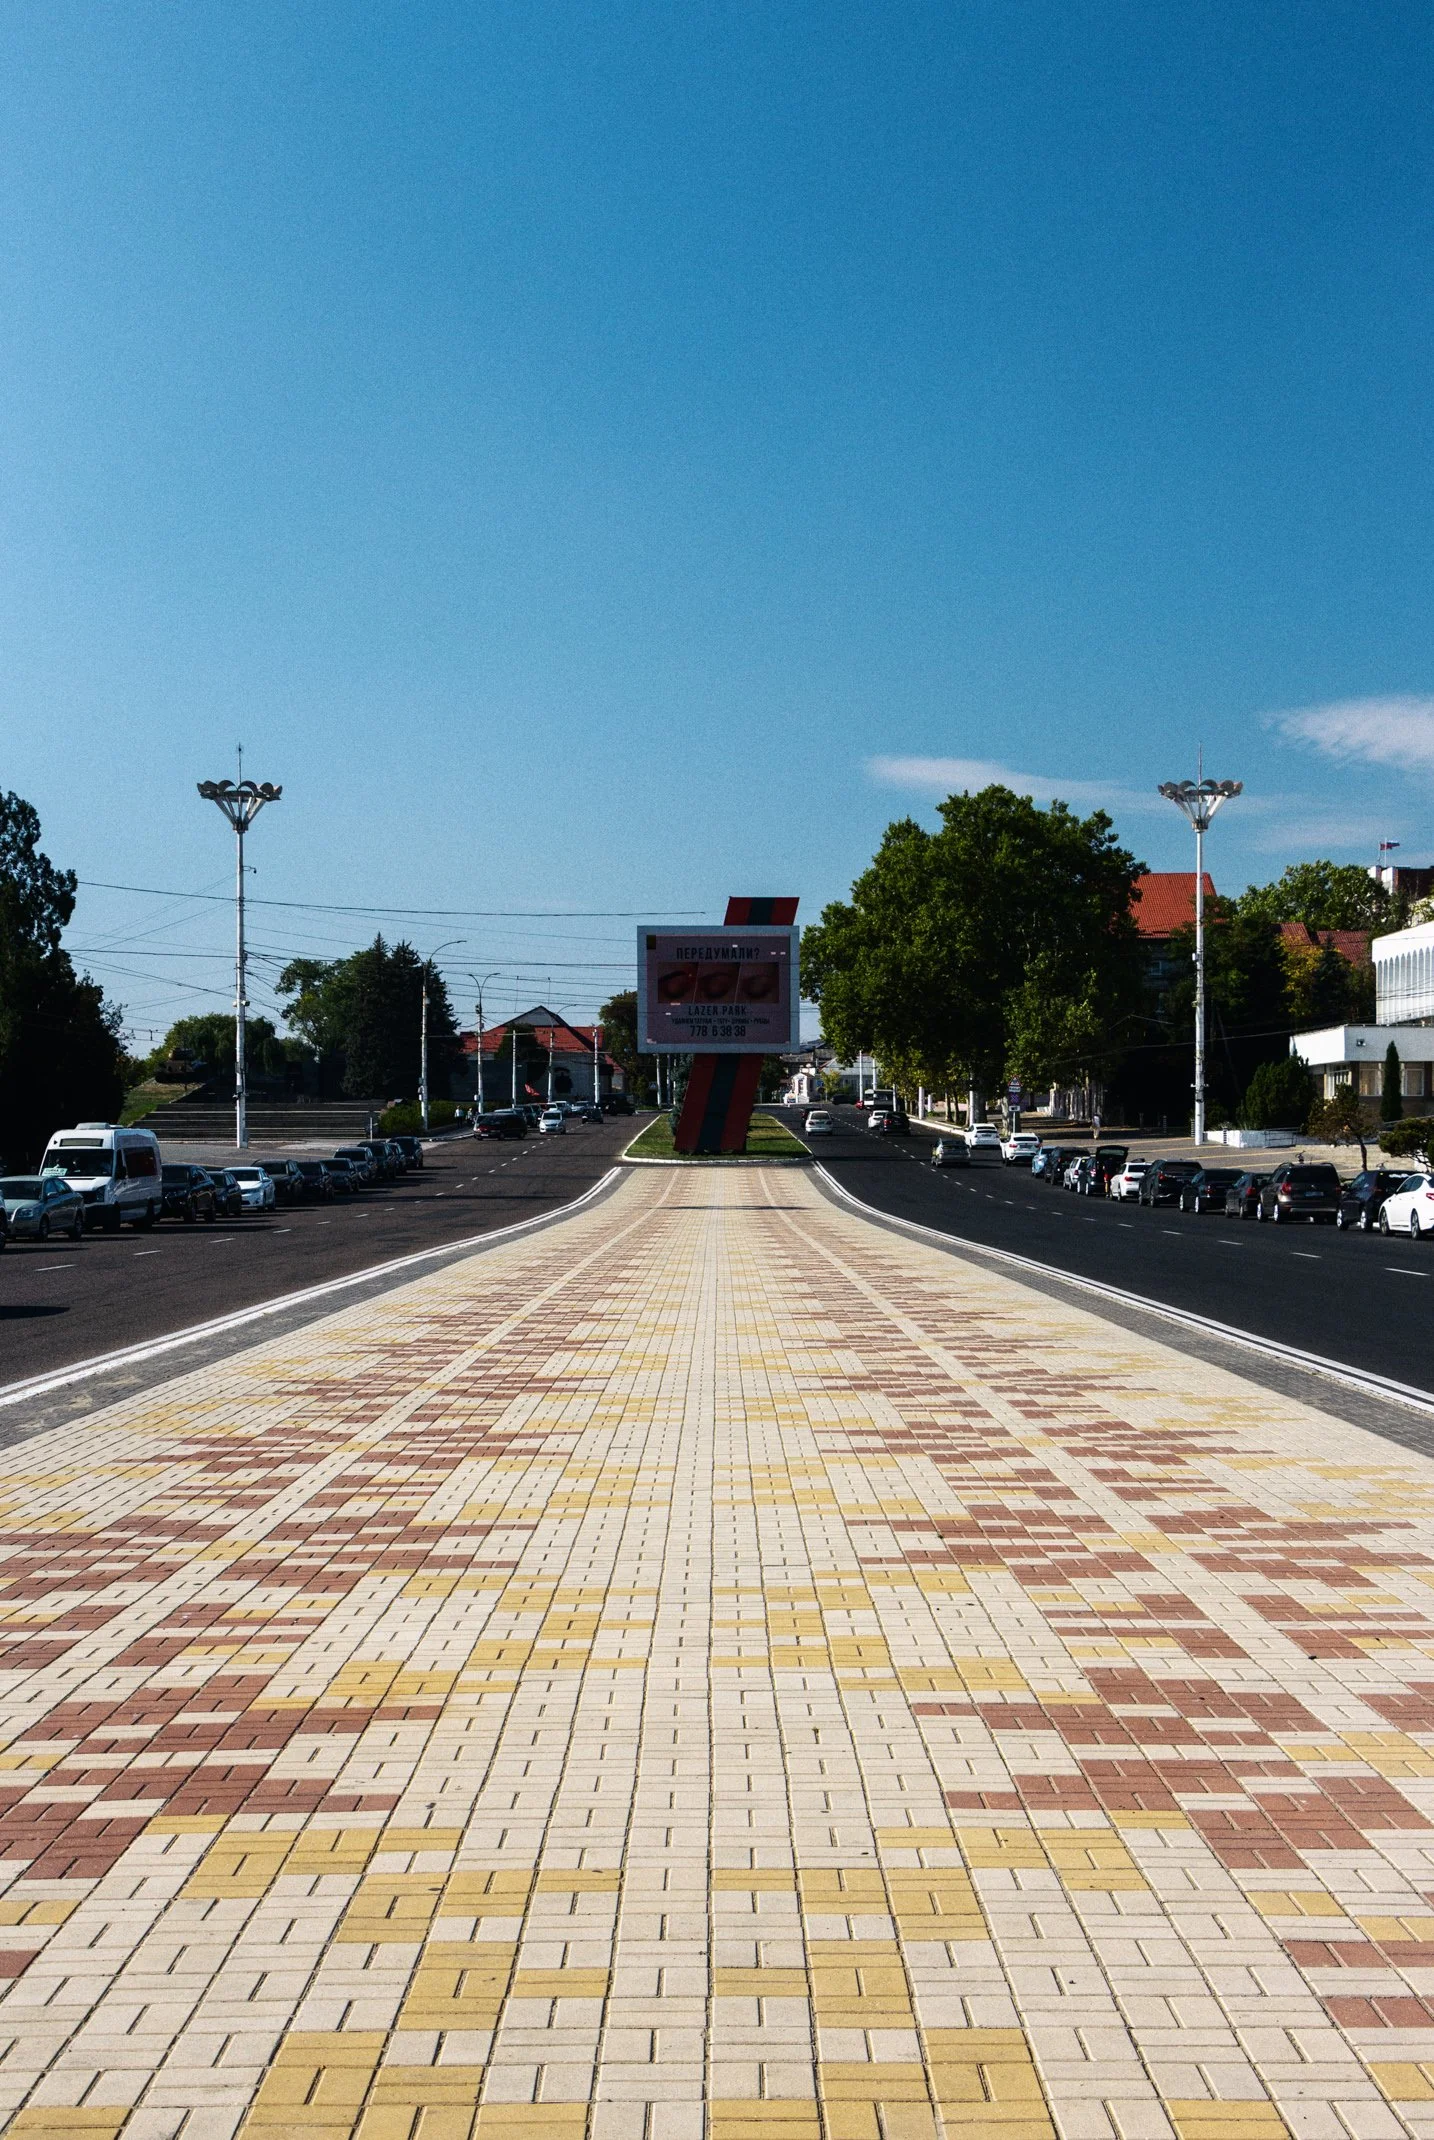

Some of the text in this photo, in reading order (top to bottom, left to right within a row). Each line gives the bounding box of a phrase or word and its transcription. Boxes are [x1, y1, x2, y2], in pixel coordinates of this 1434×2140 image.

[676, 947, 760, 960] ПЕРЕДУМАЛИ?
[688, 1005, 746, 1016] LAZER PARK
[690, 1025, 708, 1037] 778
